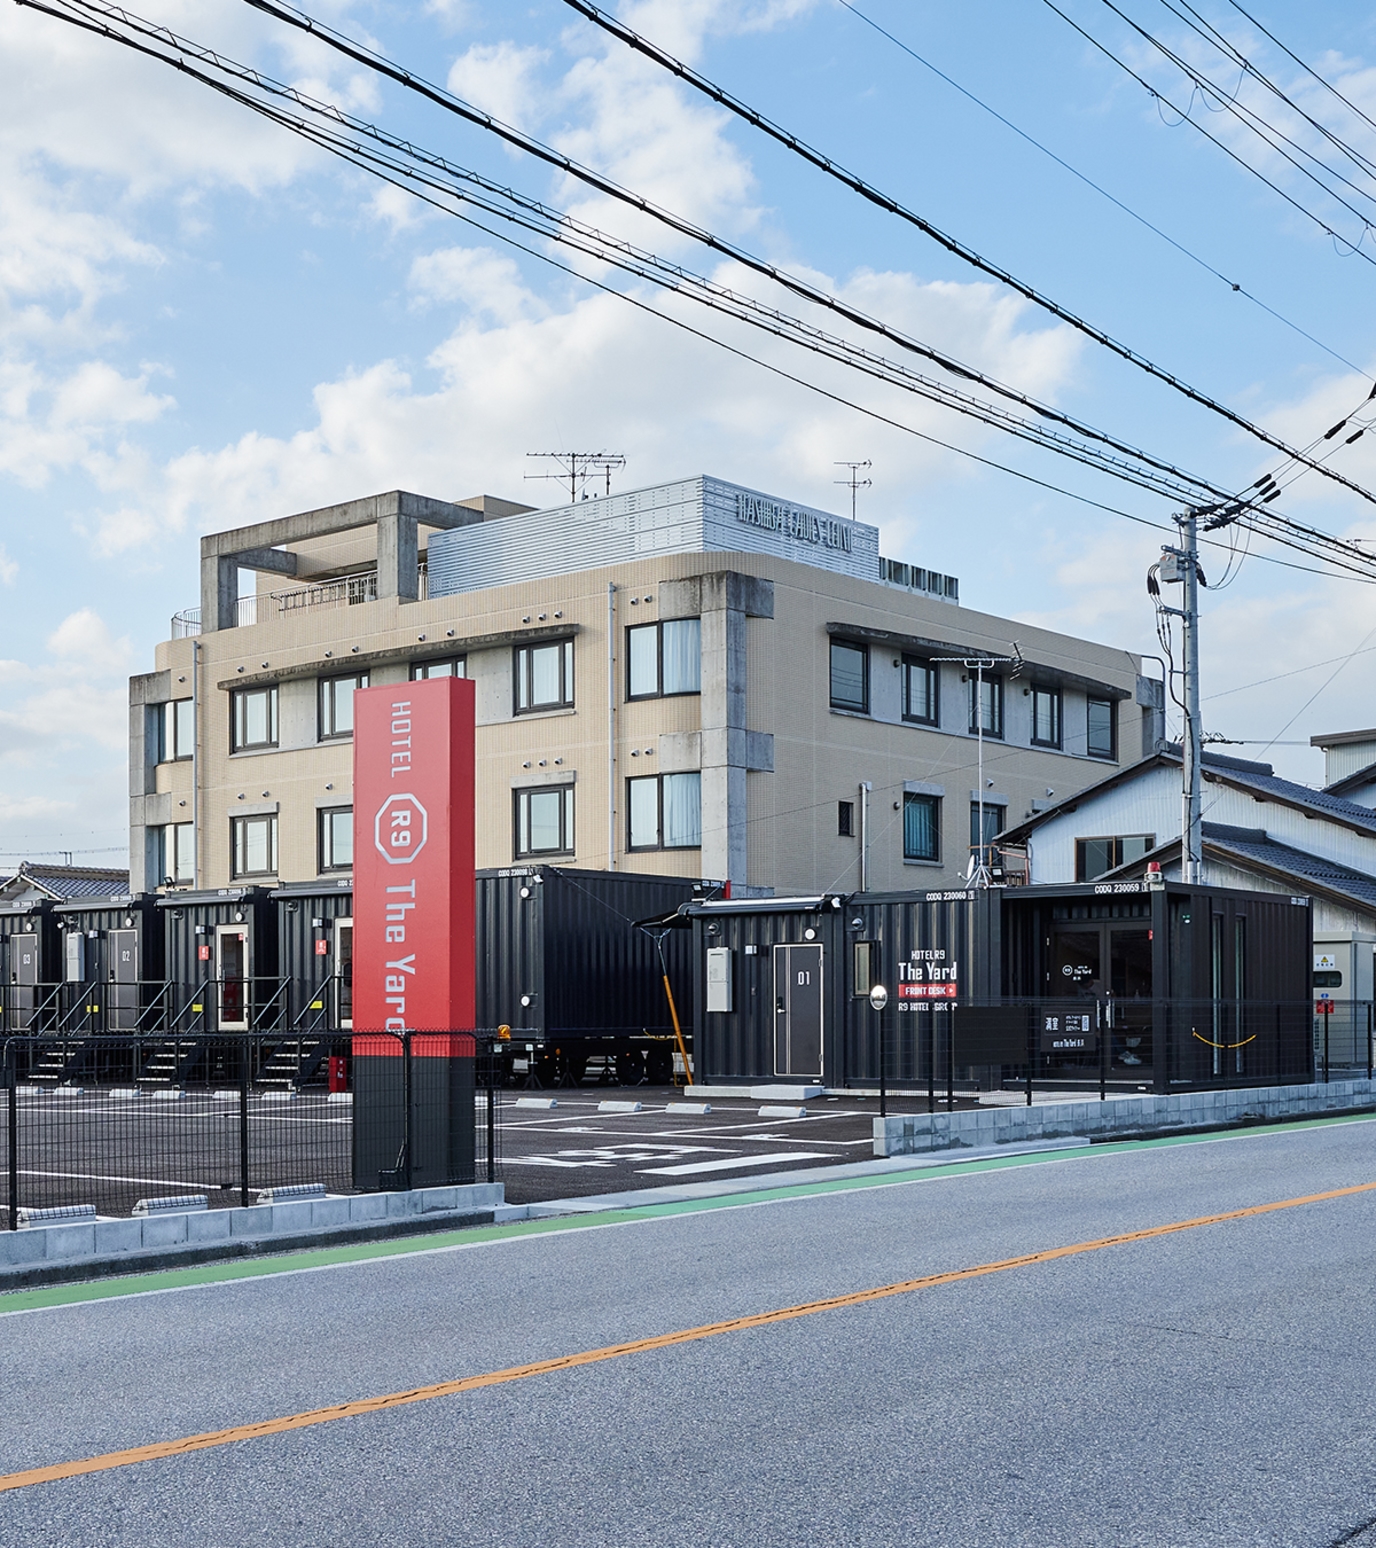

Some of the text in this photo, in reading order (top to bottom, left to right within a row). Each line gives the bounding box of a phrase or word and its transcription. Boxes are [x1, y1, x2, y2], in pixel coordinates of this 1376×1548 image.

[390, 701, 412, 847] HOTEL R9
[1113, 883, 1140, 893] 230059
[122, 950, 131, 962] 02
[385, 878, 416, 1034] The Yard
[911, 949, 945, 960] HOTEL R9
[898, 961, 957, 980] The Yard
[798, 971, 810, 985] 01
[905, 986, 947, 995] FRONT DESK
[910, 1002, 931, 1011] HOTEL
